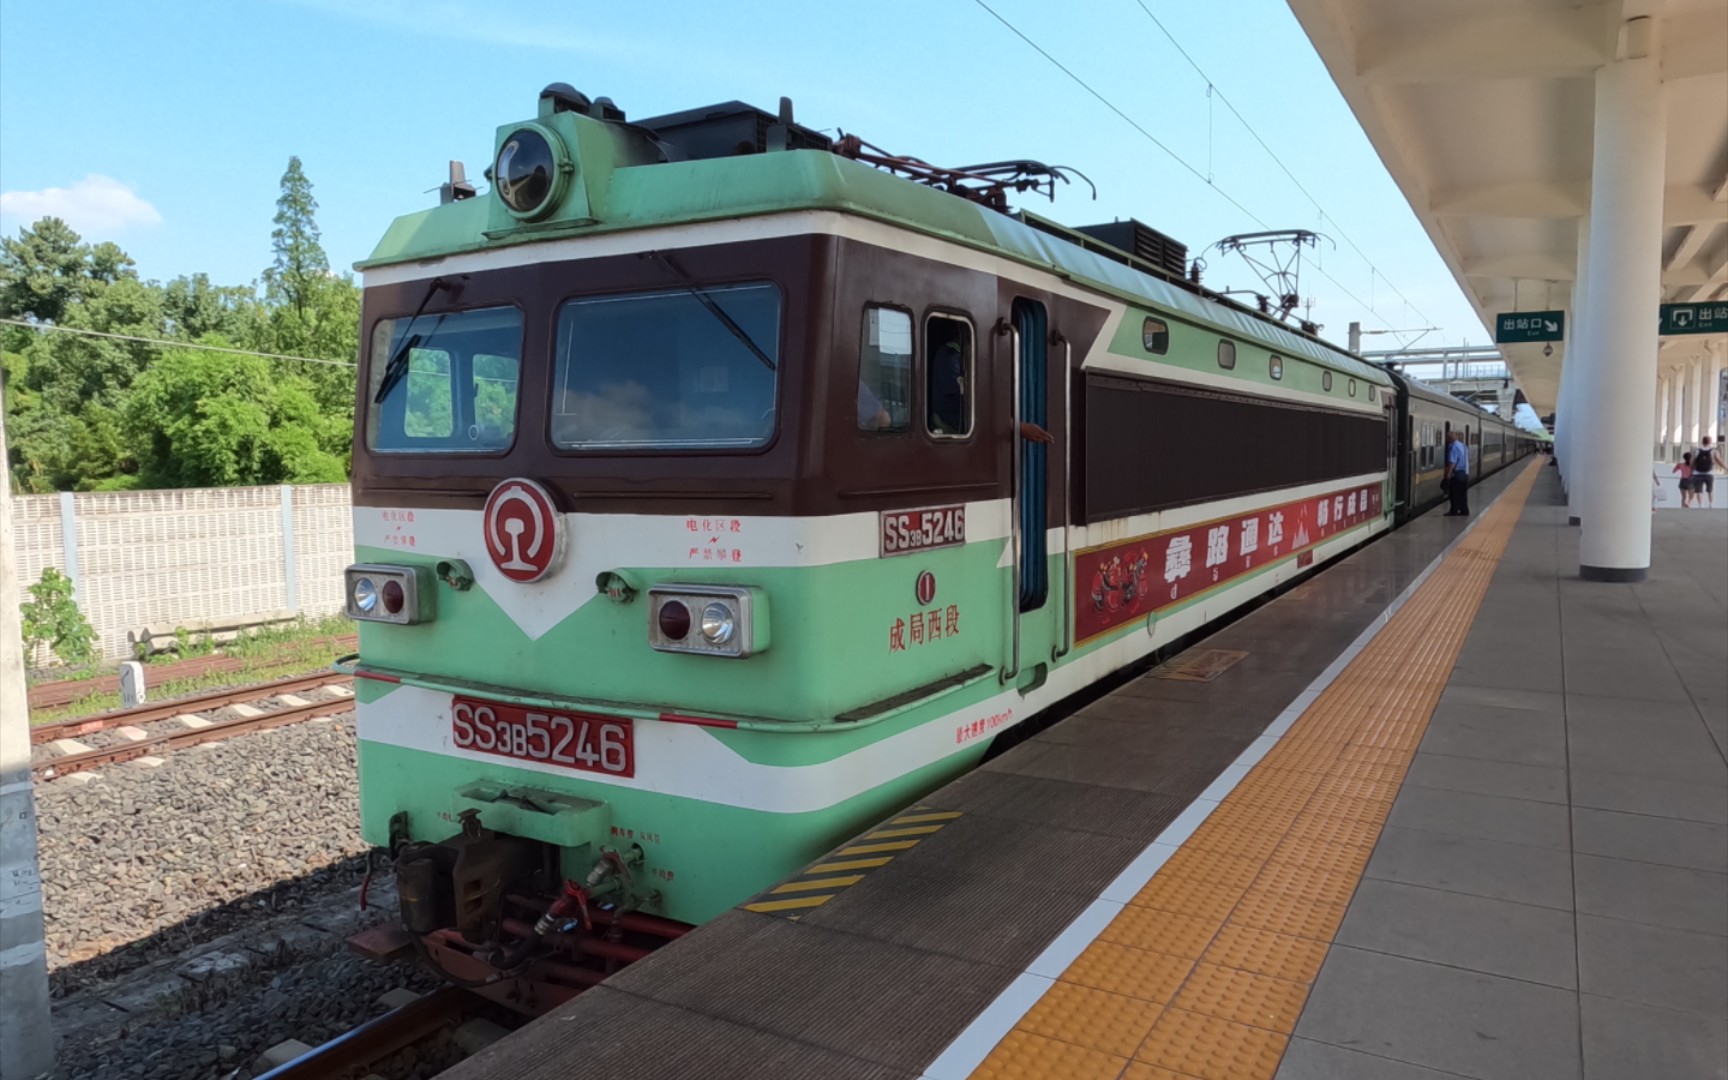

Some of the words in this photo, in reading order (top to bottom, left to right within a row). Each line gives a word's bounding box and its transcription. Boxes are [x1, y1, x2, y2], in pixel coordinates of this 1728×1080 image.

[1503, 318, 1542, 330] 出站口
[687, 518, 741, 532] 电化区段
[885, 509, 965, 551] SS3B5246
[888, 604, 960, 655] 成局西段
[453, 703, 626, 772] SS3B5246
